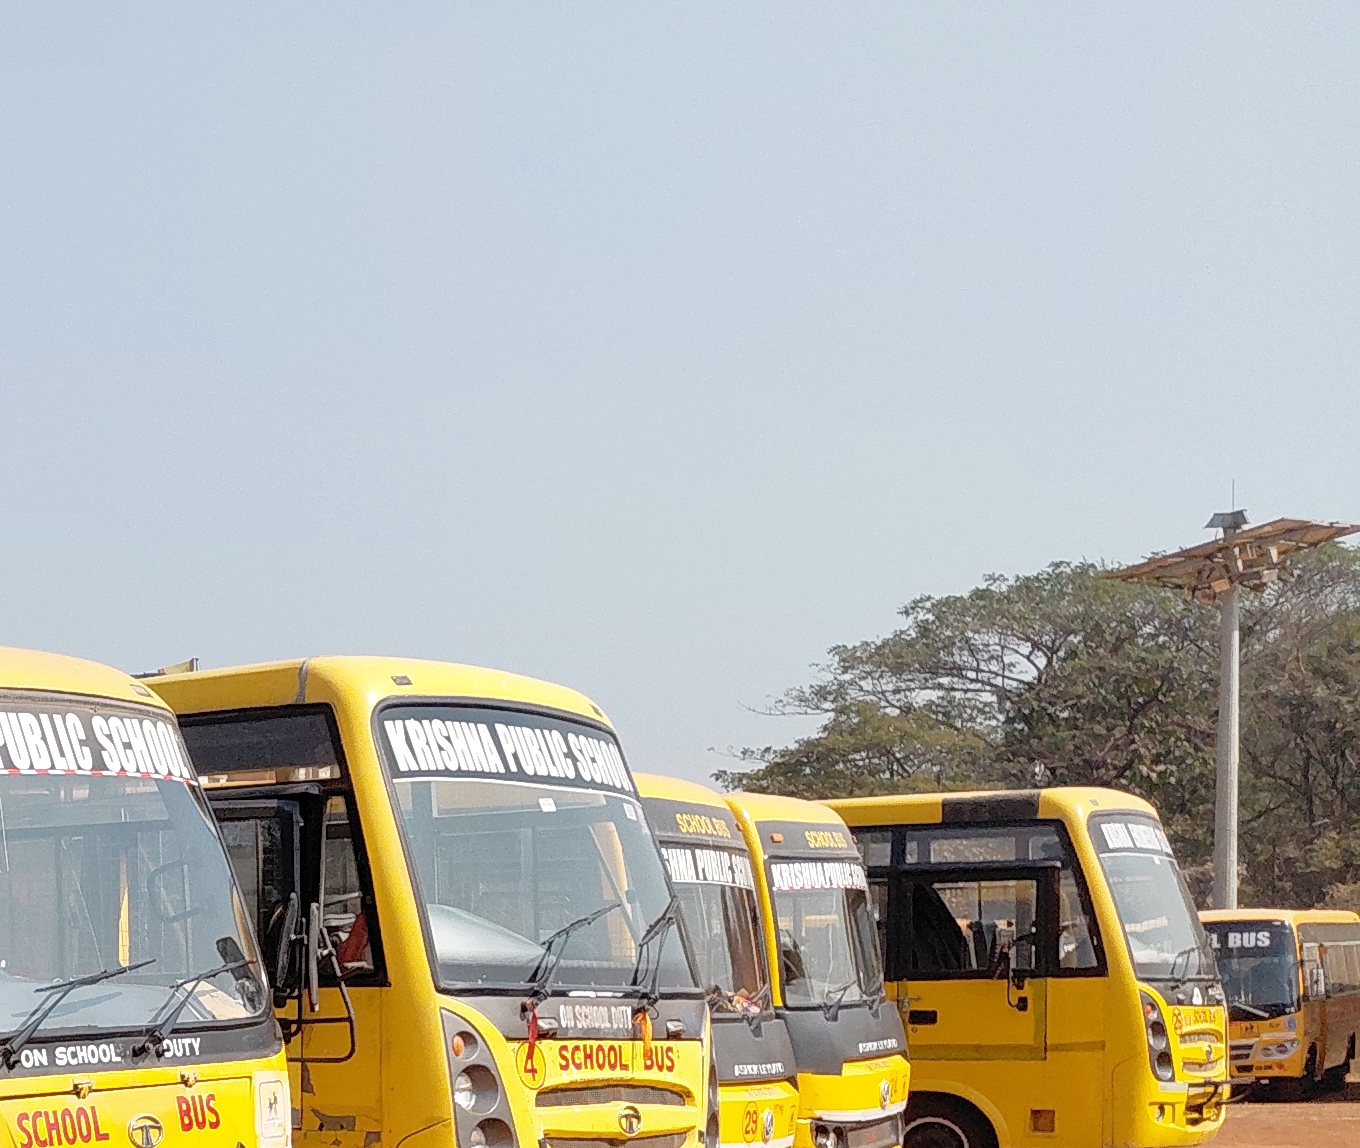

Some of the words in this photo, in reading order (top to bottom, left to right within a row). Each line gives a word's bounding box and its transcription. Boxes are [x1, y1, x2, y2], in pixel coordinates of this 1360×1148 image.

[91, 715, 191, 780] SCHOOL
[383, 718, 506, 776] KRISHNA
[494, 721, 576, 779] PUBLIC
[567, 732, 635, 793] SCHOOL
[675, 813, 718, 836] SCHOOL
[695, 848, 733, 884] PUBLIC
[771, 862, 828, 888] KRISHNA
[1227, 930, 1271, 949] BUS
[574, 1004, 612, 1029] SCHOOL
[20, 1048, 49, 1069] ON
[54, 1043, 122, 1066] SCHOOL
[523, 1048, 539, 1081] 4
[558, 1044, 630, 1071] SCHOOL
[642, 1045, 675, 1073] BUS
[176, 1093, 220, 1133] BUS
[744, 1109, 758, 1135] 29
